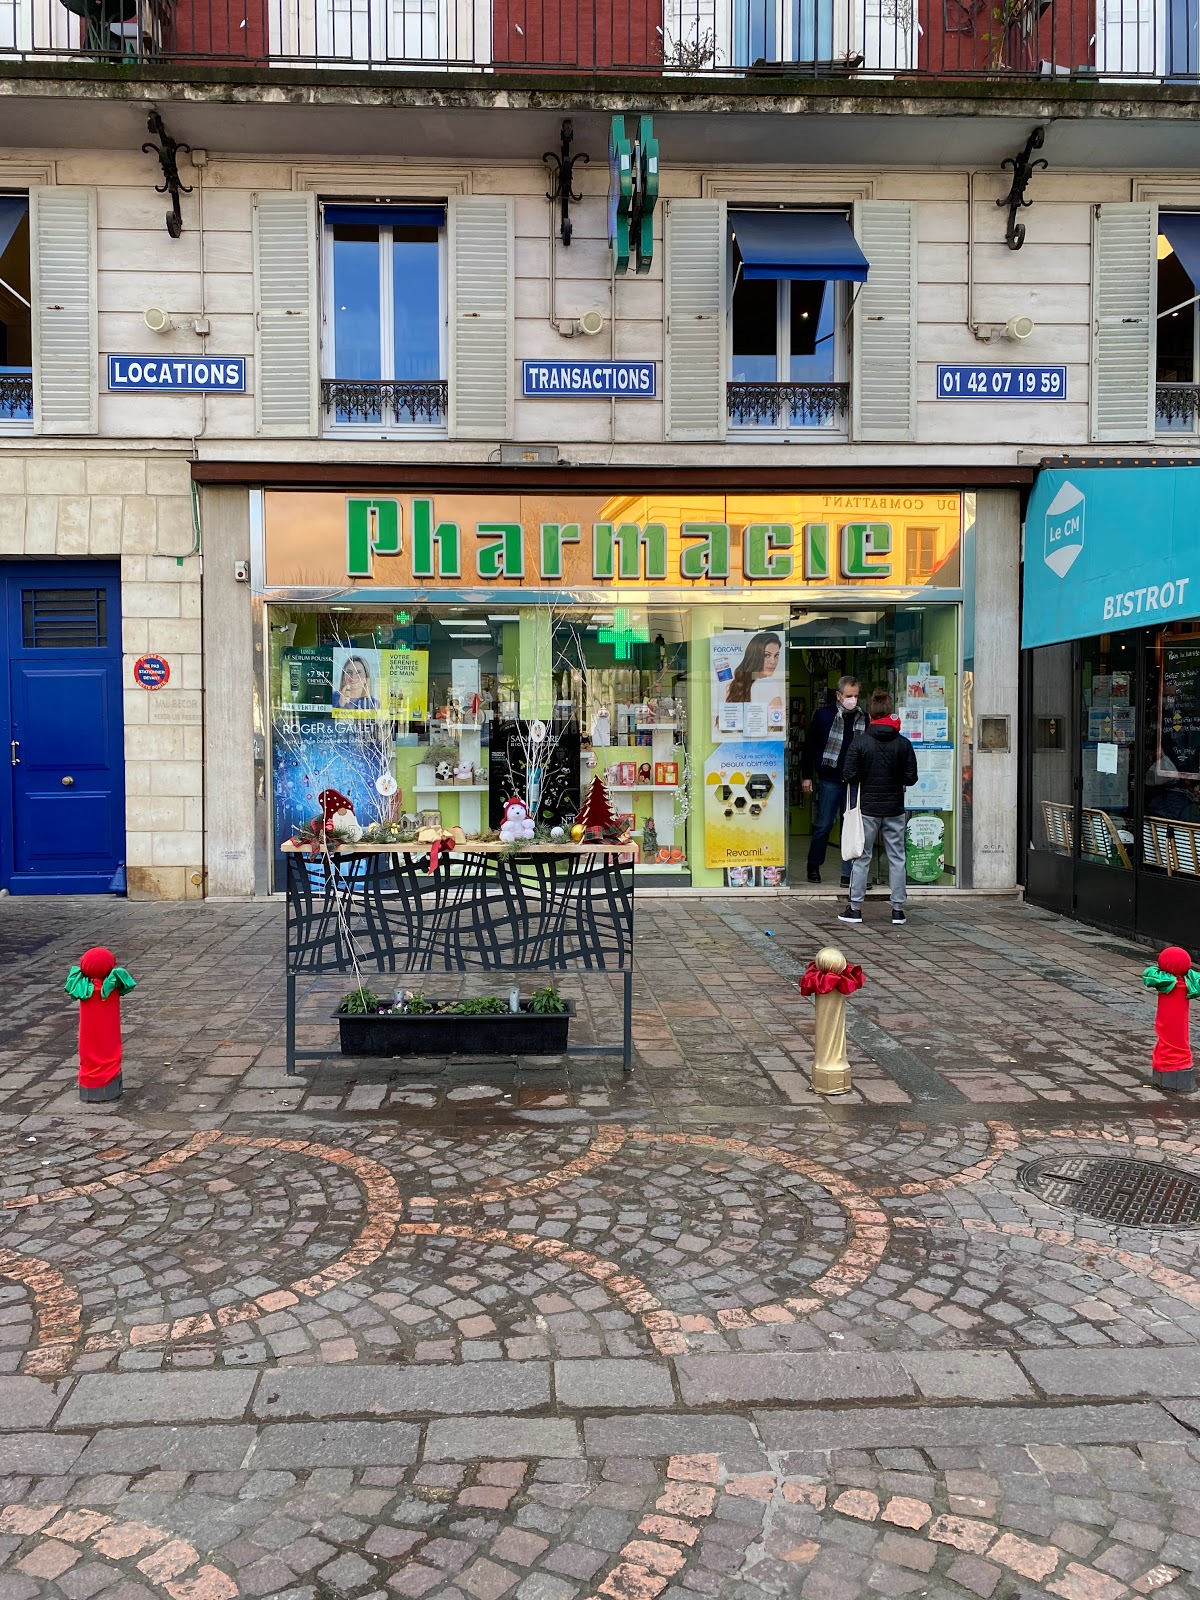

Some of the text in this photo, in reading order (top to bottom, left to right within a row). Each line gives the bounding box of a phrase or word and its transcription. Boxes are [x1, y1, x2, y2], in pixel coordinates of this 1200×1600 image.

[114, 362, 240, 385] LOCATIONS
[529, 368, 650, 389] TRANSACTIONS
[943, 372, 1060, 393] 01 42 07 19 59
[345, 496, 892, 579] Pharmacie
[1049, 515, 1080, 543] Le CM
[1103, 577, 1190, 620] BISTROT
[283, 722, 375, 735] ROGER & GALLET
[510, 735, 559, 743] SANORE
[721, 761, 744, 769] peaux
